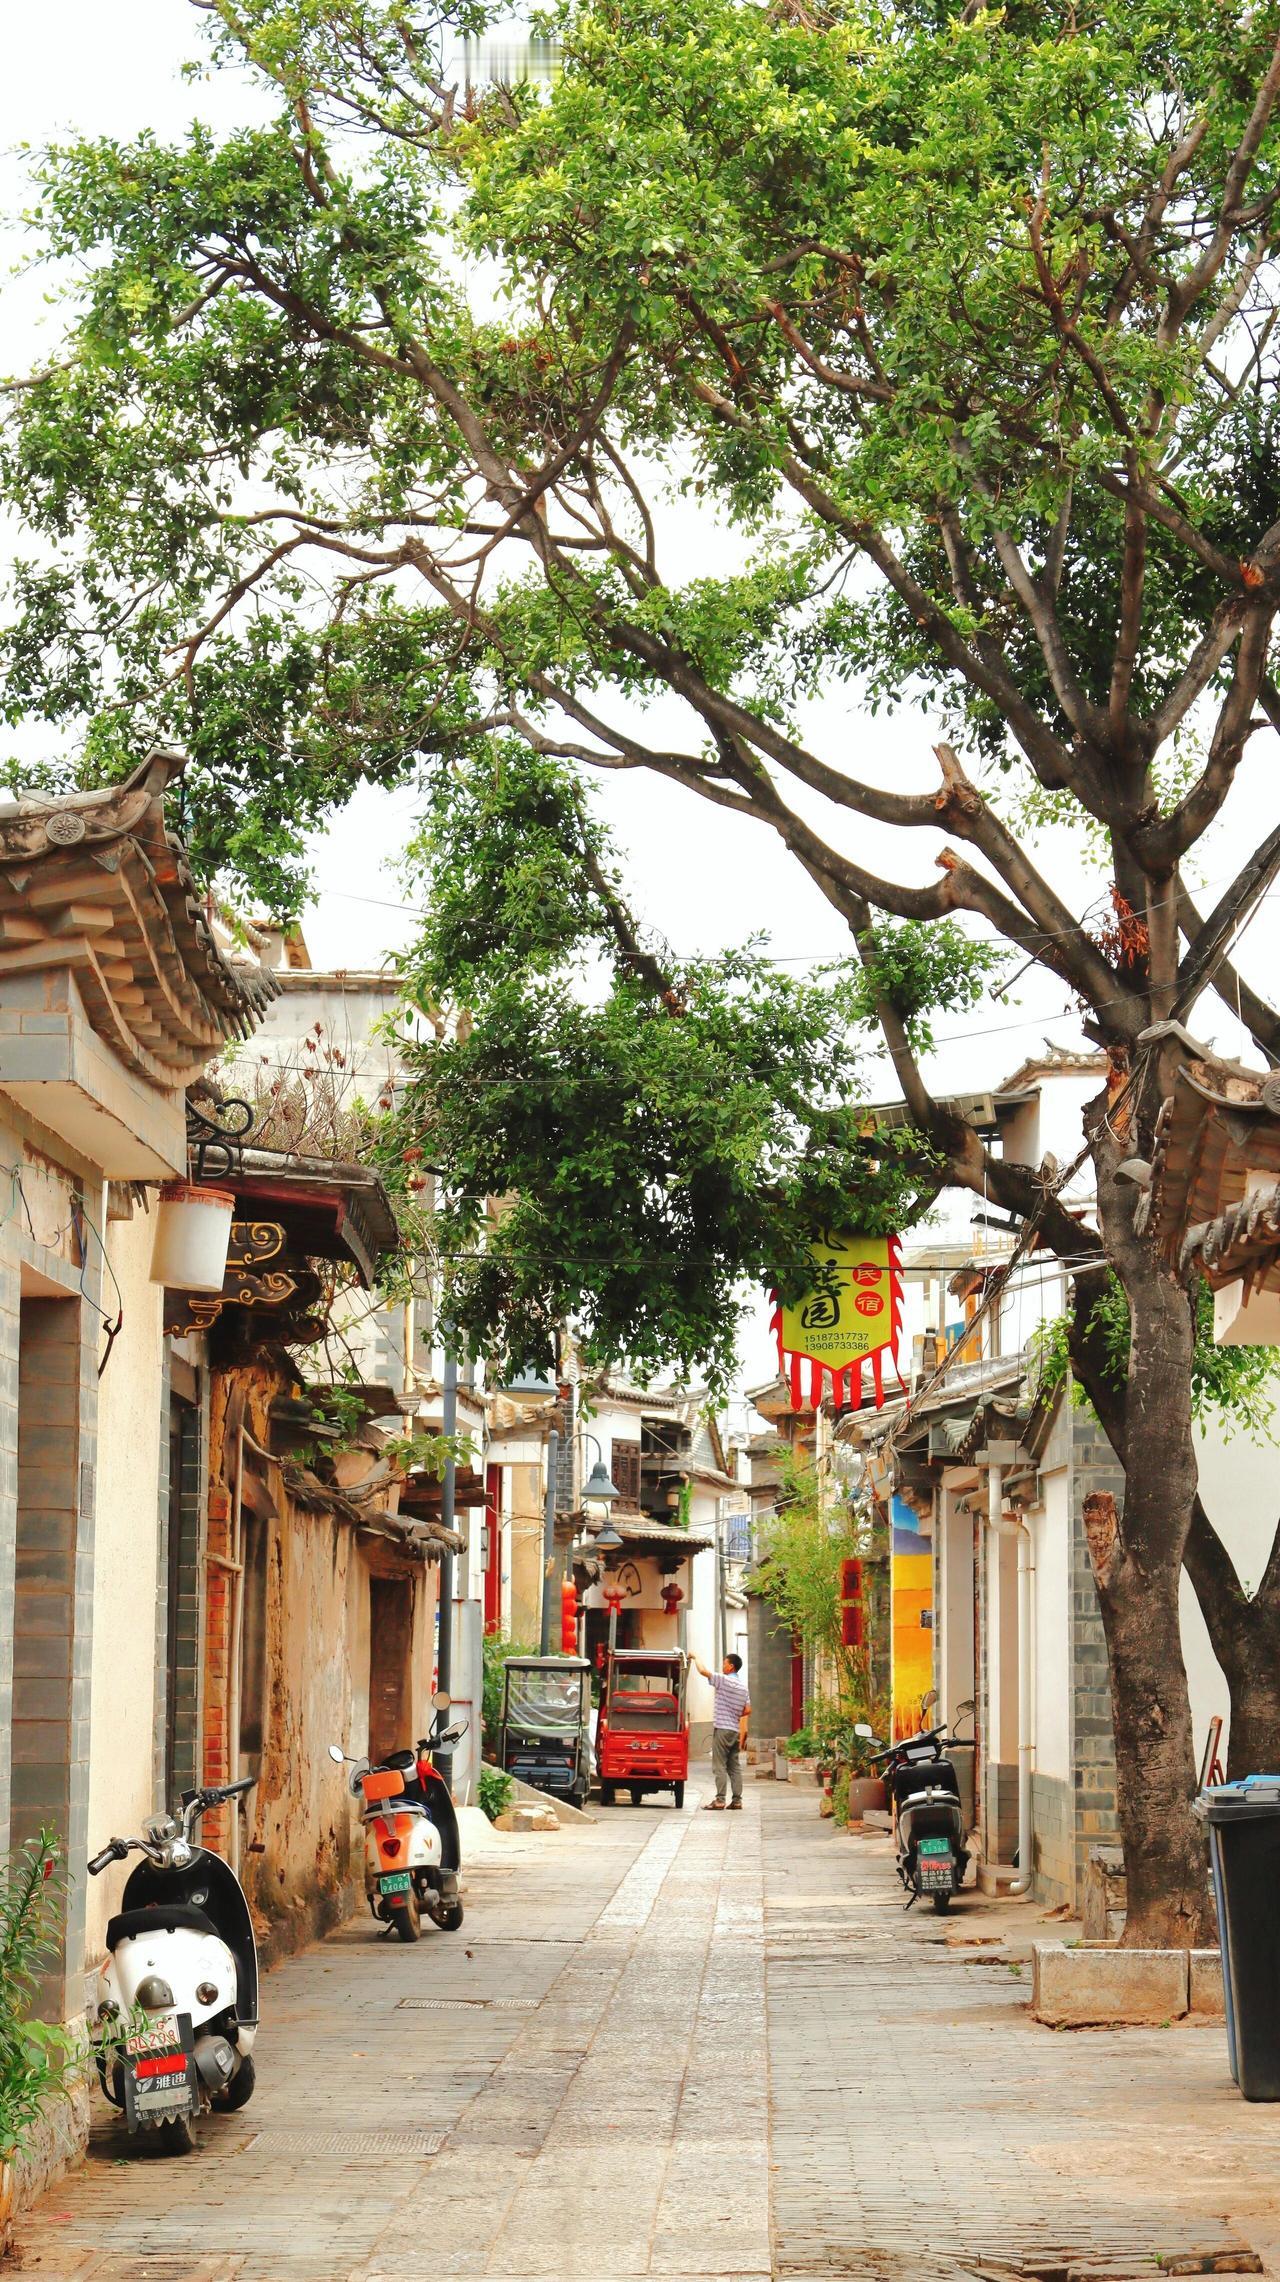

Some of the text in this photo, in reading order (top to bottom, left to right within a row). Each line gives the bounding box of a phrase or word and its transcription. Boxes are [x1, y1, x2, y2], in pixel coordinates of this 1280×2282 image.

[855, 1267, 881, 1312] 民宿
[804, 1332, 869, 1343] 15187317737
[804, 1341, 870, 1351] 13908733386
[156, 2072, 187, 2089] 雅迪
